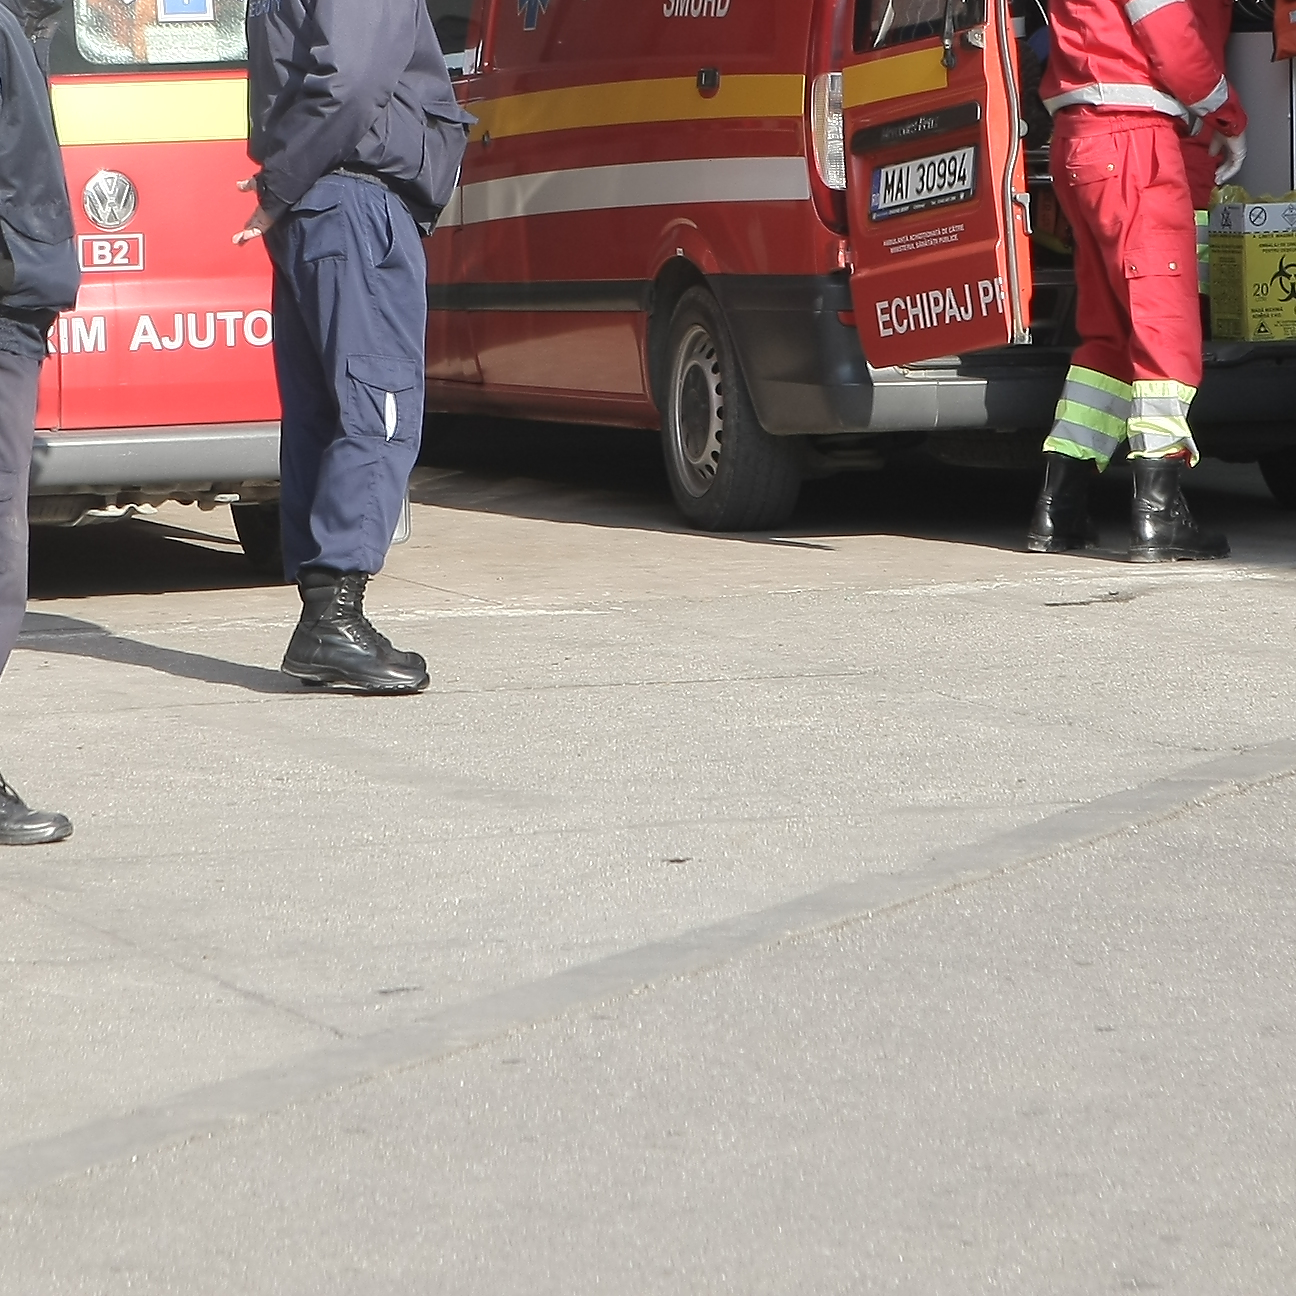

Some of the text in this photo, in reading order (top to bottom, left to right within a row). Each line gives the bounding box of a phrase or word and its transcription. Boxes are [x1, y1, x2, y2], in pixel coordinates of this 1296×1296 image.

[883, 166, 911, 205] MAI
[916, 152, 968, 195] 30994
[93, 240, 130, 265] B2
[1253, 282, 1269, 296] 20
[875, 284, 973, 337] ECHIPAJ
